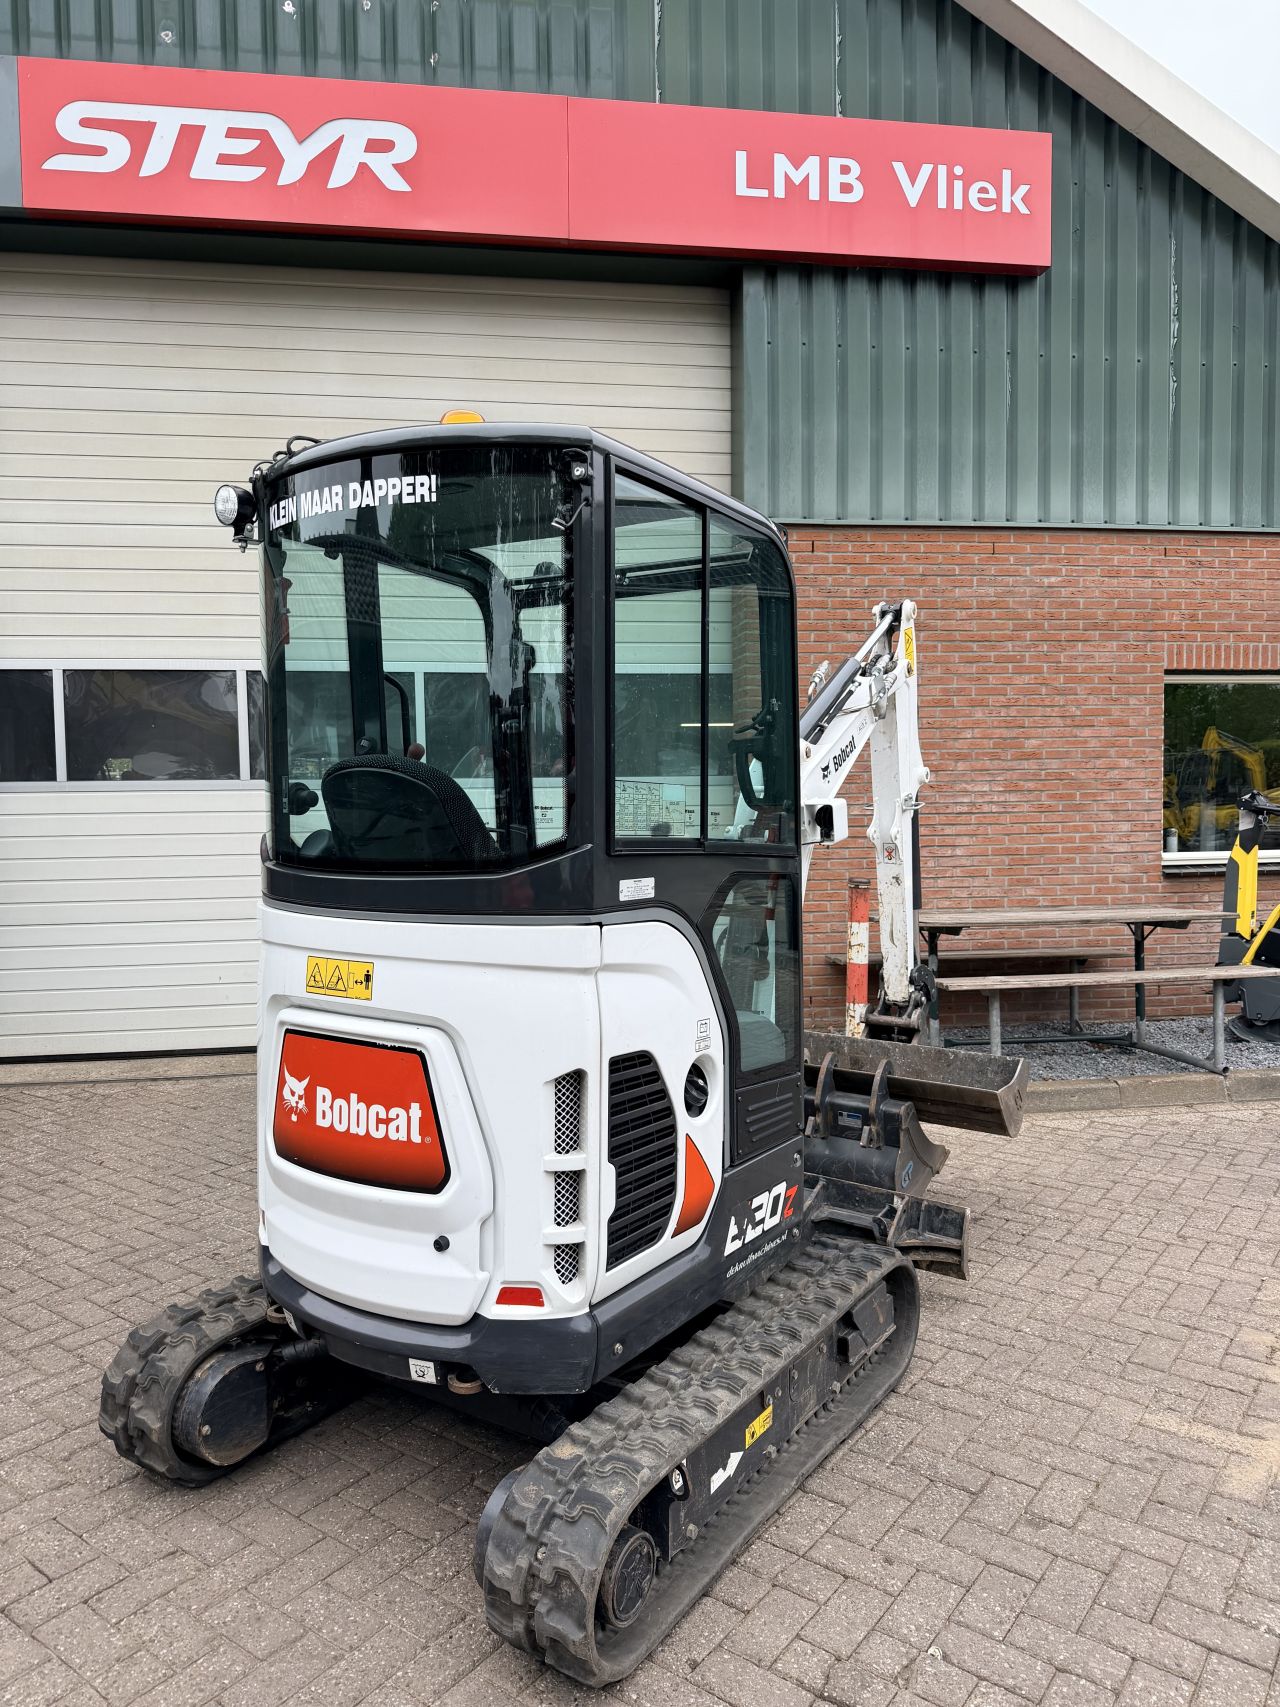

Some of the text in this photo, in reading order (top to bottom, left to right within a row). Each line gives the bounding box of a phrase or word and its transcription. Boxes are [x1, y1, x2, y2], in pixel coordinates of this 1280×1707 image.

[41, 100, 418, 192] STEYR
[735, 150, 1032, 215] LMB Vliek
[269, 474, 437, 531] KLEIN MAAR DAPPER!
[832, 734, 857, 773] Bobcat
[316, 1085, 422, 1144] Bobcat
